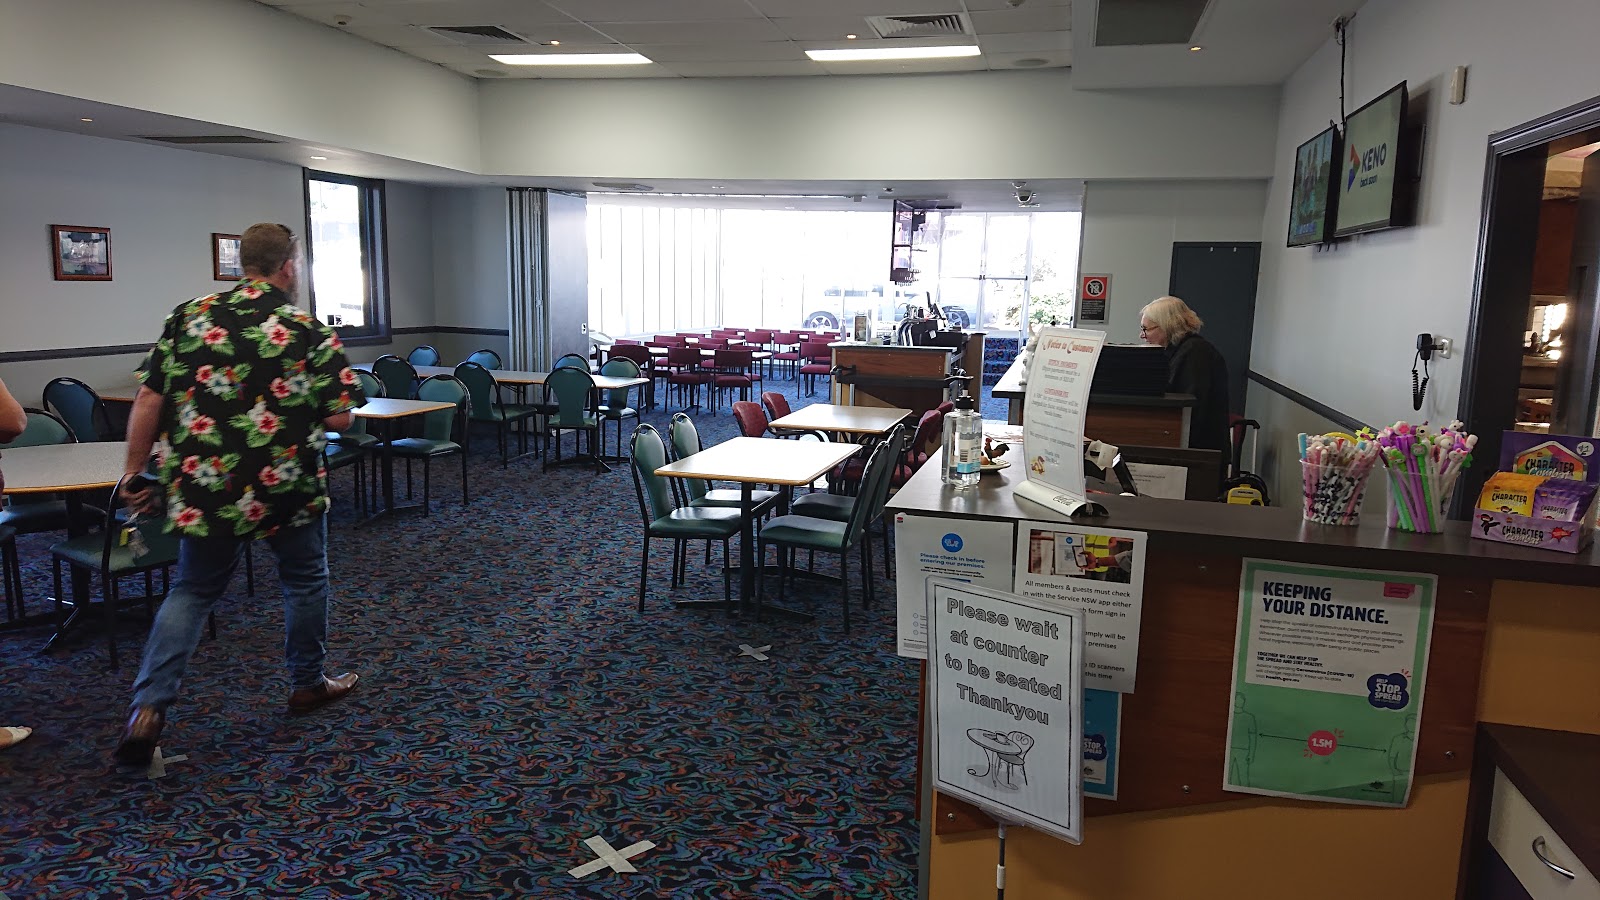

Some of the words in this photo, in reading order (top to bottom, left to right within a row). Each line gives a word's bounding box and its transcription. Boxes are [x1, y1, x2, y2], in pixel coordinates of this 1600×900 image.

[1361, 142, 1387, 173] KENO
[1067, 341, 1094, 354] Customers
[1525, 458, 1575, 476] CHARACTER
[1492, 493, 1528, 505] CHARACTER
[1540, 504, 1568, 515] CHARACTER
[1502, 526, 1544, 541] CHARACTER
[956, 561, 985, 569] premises.
[1034, 580, 1063, 590] members
[1072, 585, 1092, 594] guests
[1111, 589, 1130, 598] check
[1263, 581, 1332, 602] KEEPING
[1057, 594, 1080, 602] Service
[1111, 600, 1131, 608] either
[1263, 598, 1304, 616] YOUR
[1310, 602, 1388, 624] DISTANCE.
[947, 597, 1009, 627] Please
[1014, 616, 1058, 640] wait
[1085, 630, 1103, 638] omply
[950, 628, 968, 646] at
[974, 635, 1048, 666] counter
[1088, 640, 1116, 649] premises
[1097, 663, 1125, 672] scanners
[945, 654, 962, 670] to
[968, 658, 990, 679] be
[996, 670, 1062, 700] seated
[1375, 683, 1400, 694] STOP
[957, 683, 1049, 725] Thankyou
[1374, 692, 1402, 702] SPREAD
[1312, 738, 1332, 748] 1.5M
